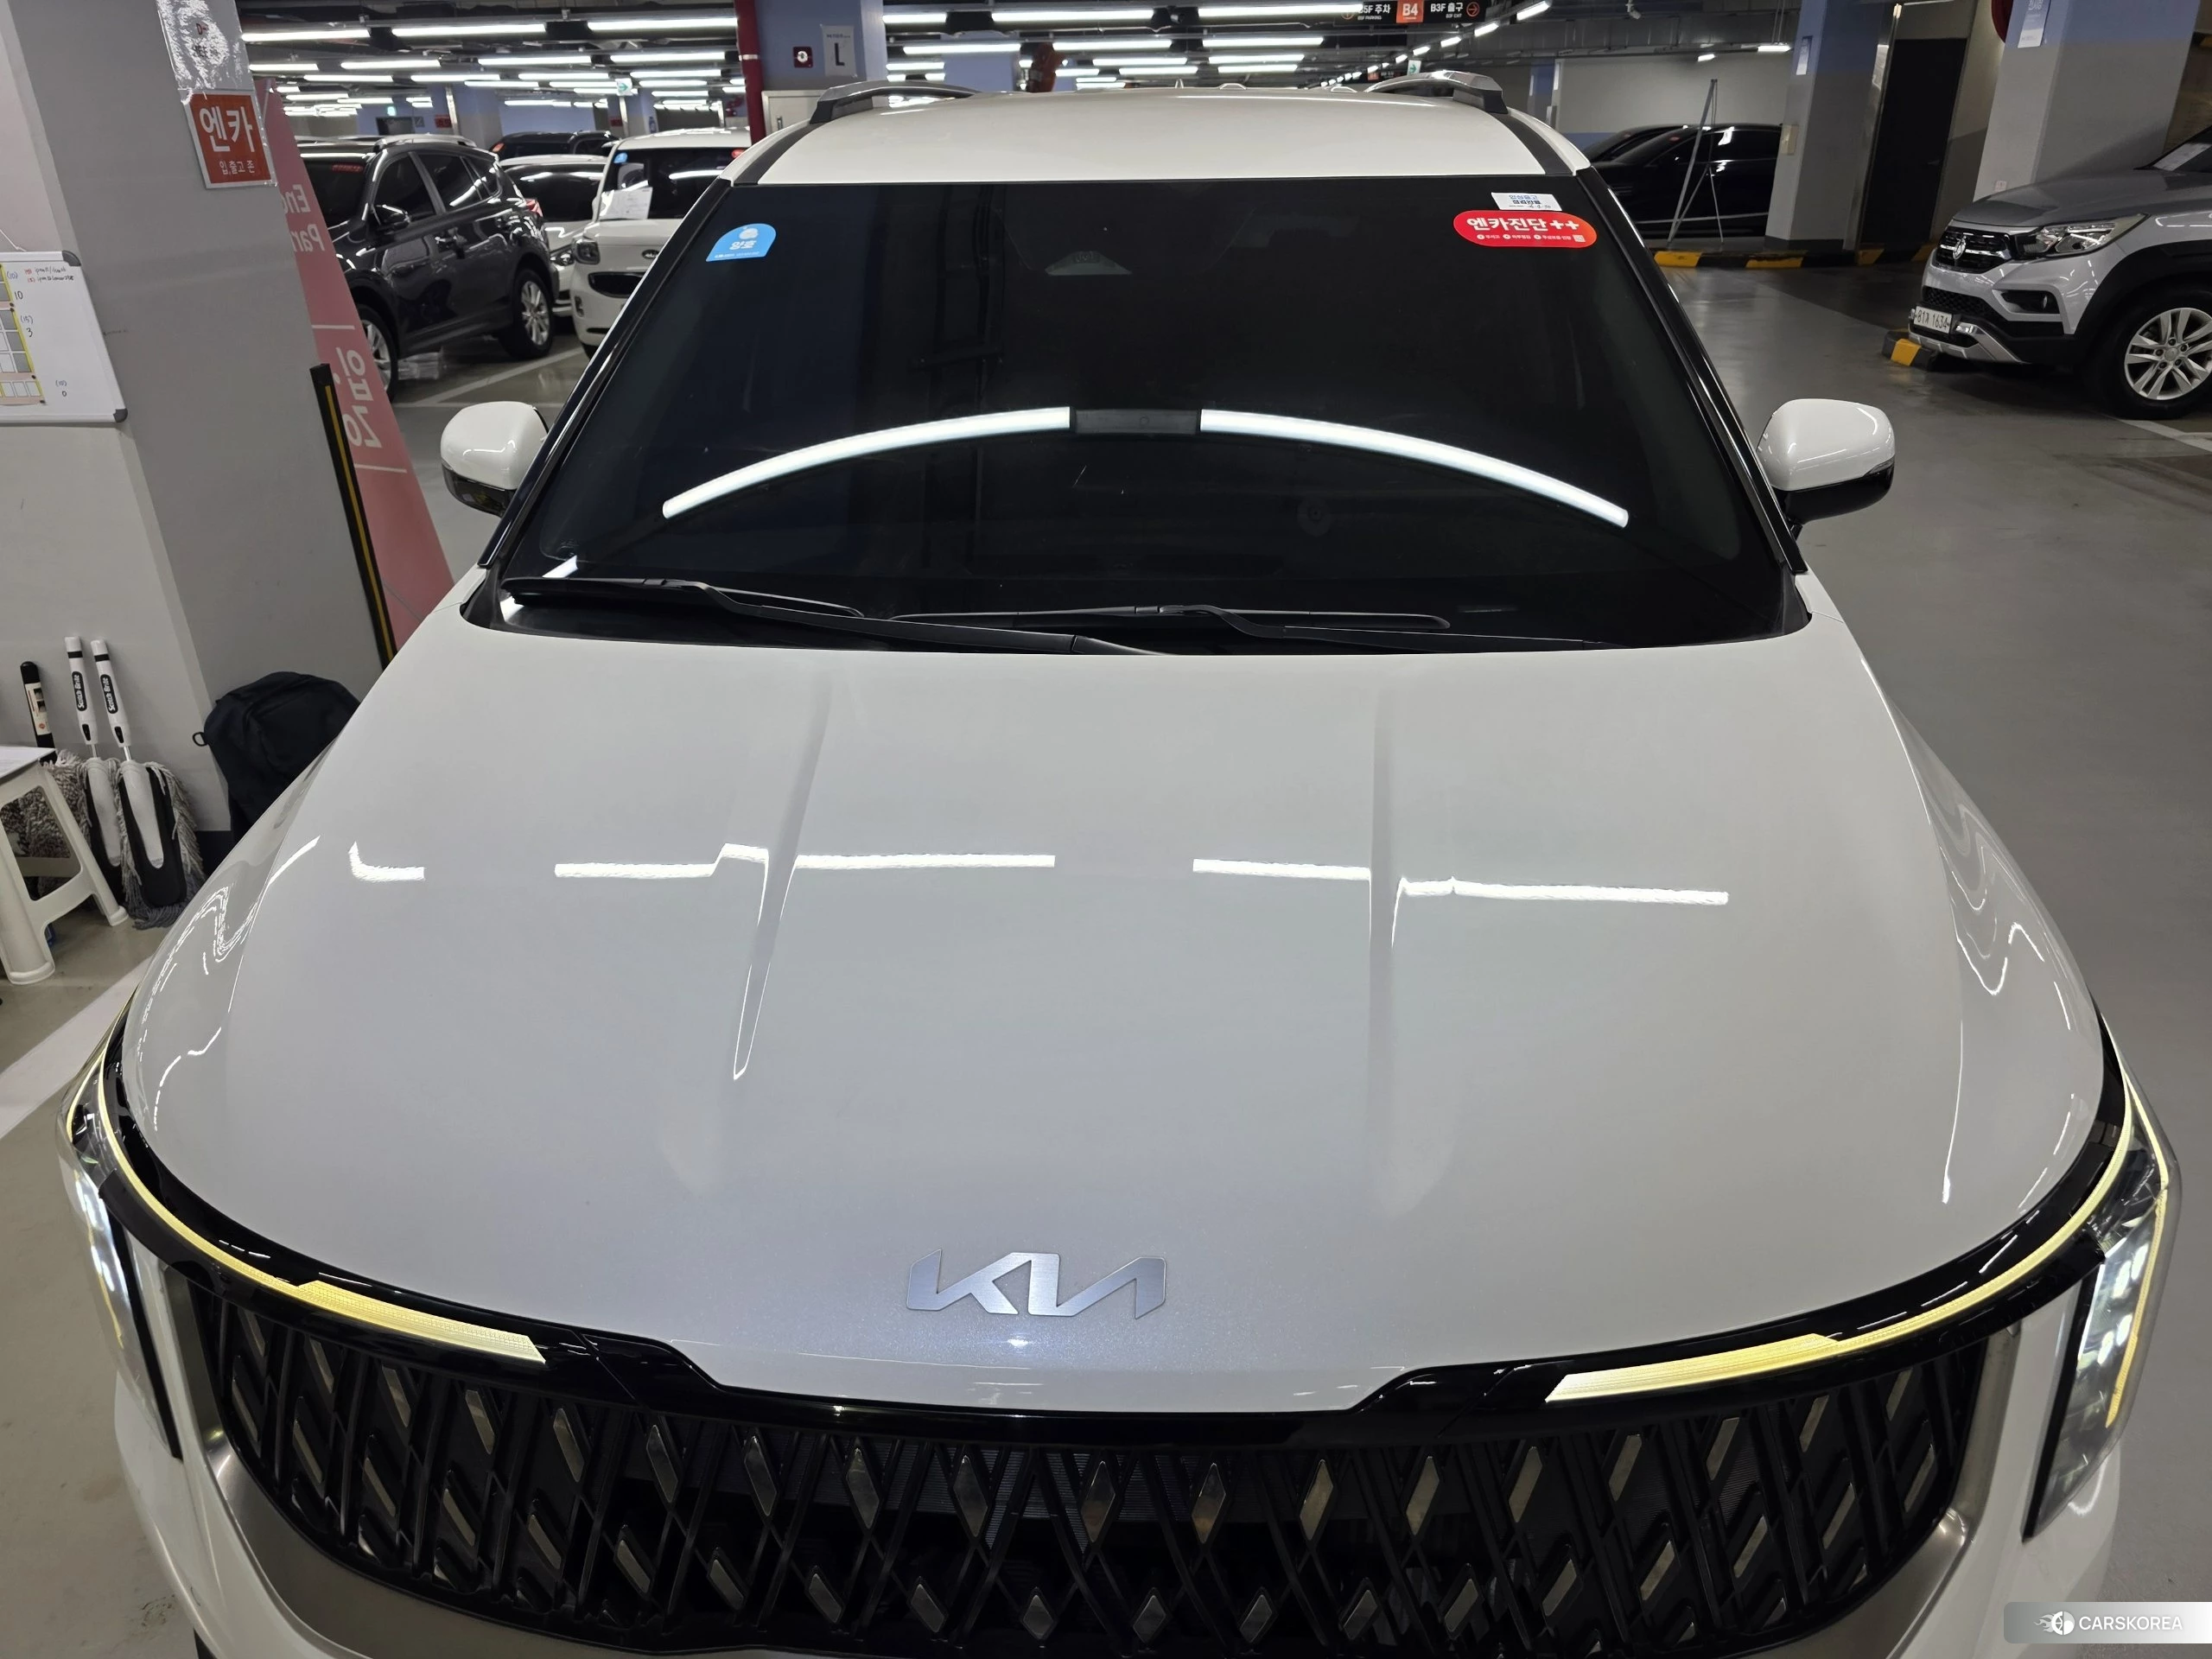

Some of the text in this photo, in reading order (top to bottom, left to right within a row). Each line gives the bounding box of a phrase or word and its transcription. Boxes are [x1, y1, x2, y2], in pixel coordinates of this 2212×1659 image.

[1358, 3, 1391, 15] 5F 주차
[1402, 3, 1419, 16] B4
[1430, 3, 1464, 12] B3F 출구
[834, 42, 845, 66] L
[199, 105, 256, 153] 엔카
[246, 160, 256, 174] 존
[14, 290, 23, 300] 10
[26, 327, 34, 338] 3
